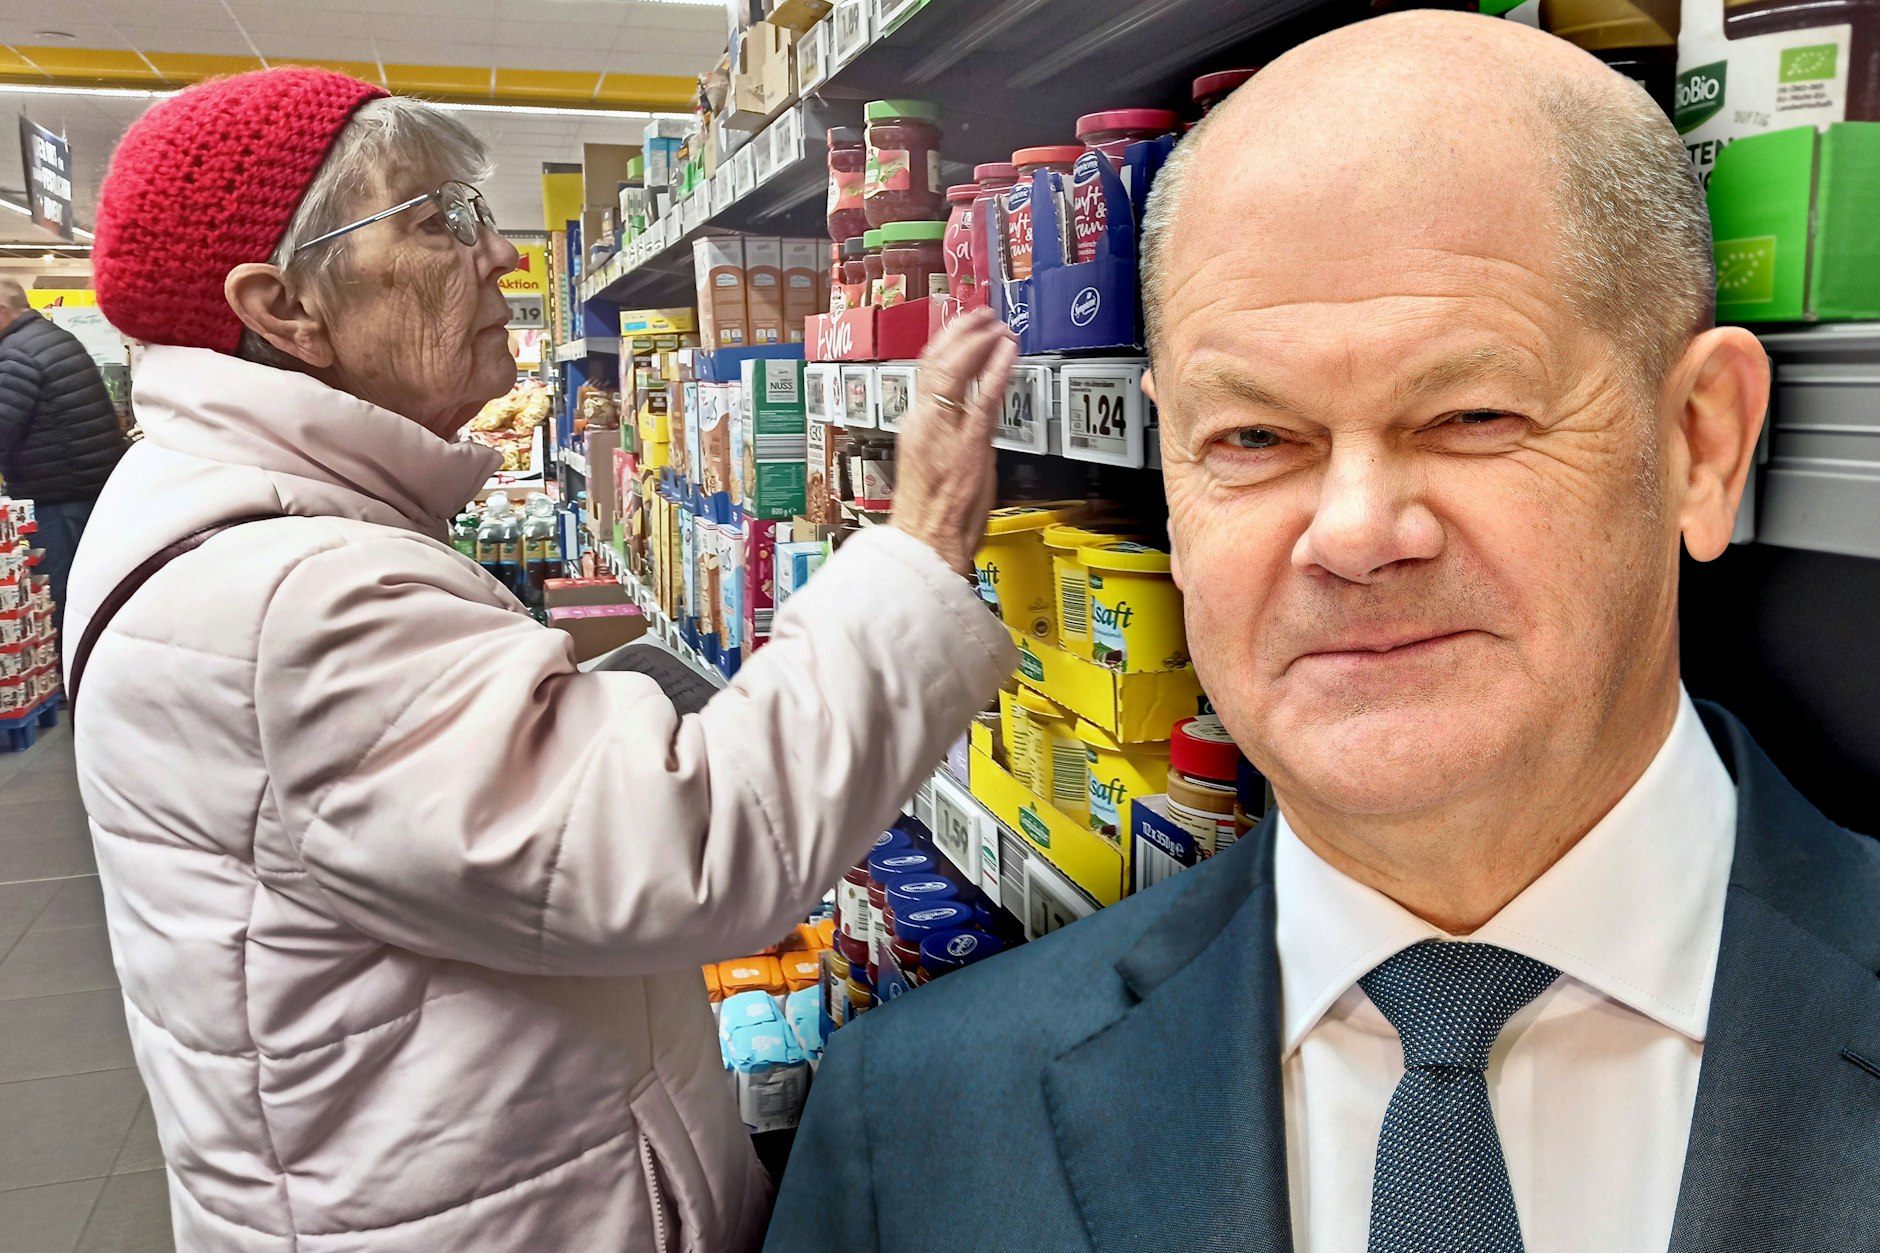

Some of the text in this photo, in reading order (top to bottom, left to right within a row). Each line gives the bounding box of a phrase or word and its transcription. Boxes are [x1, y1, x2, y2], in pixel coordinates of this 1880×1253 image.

[1095, 202, 1107, 218] &
[499, 279, 539, 289] Aktion
[770, 382, 793, 390] NUSS
[1083, 394, 1127, 437] 1.24
